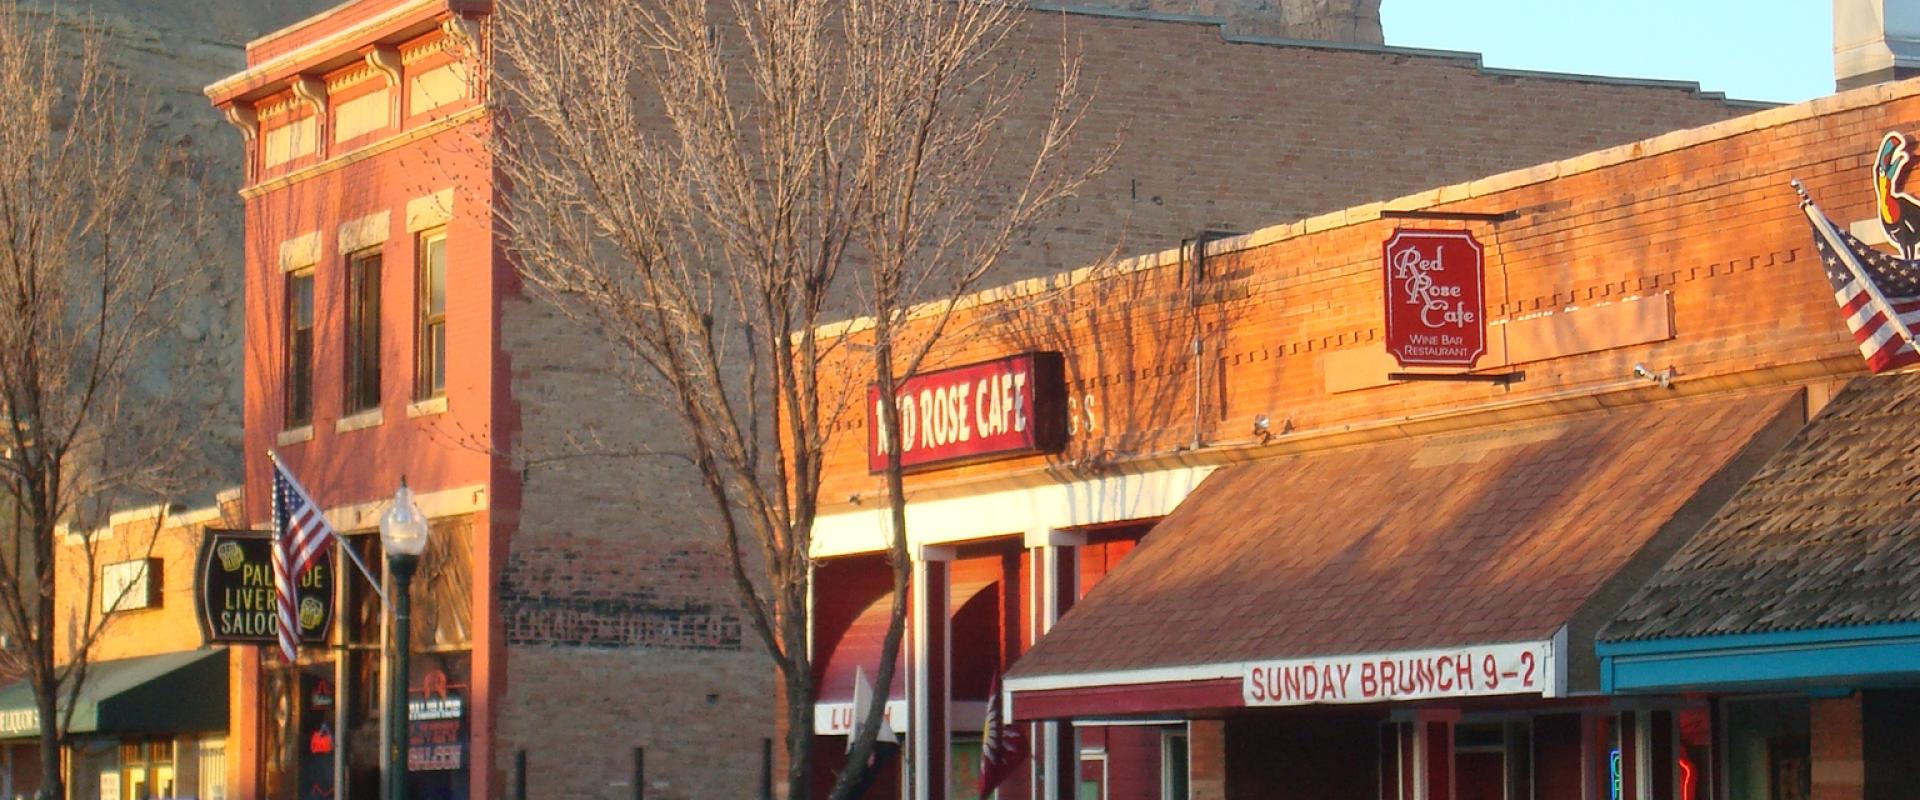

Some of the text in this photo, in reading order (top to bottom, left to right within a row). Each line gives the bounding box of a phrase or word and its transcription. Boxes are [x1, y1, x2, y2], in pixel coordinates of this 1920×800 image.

[1393, 245, 1444, 278] Red
[1405, 272, 1461, 304] Rose
[1421, 300, 1474, 328] Cafe
[876, 371, 1026, 457] RD ROSE CAFE
[225, 587, 277, 611] LIVER
[221, 611, 279, 635] SALOO
[1251, 663, 1351, 702] SUNDAY
[1360, 653, 1475, 698] BRUNCH
